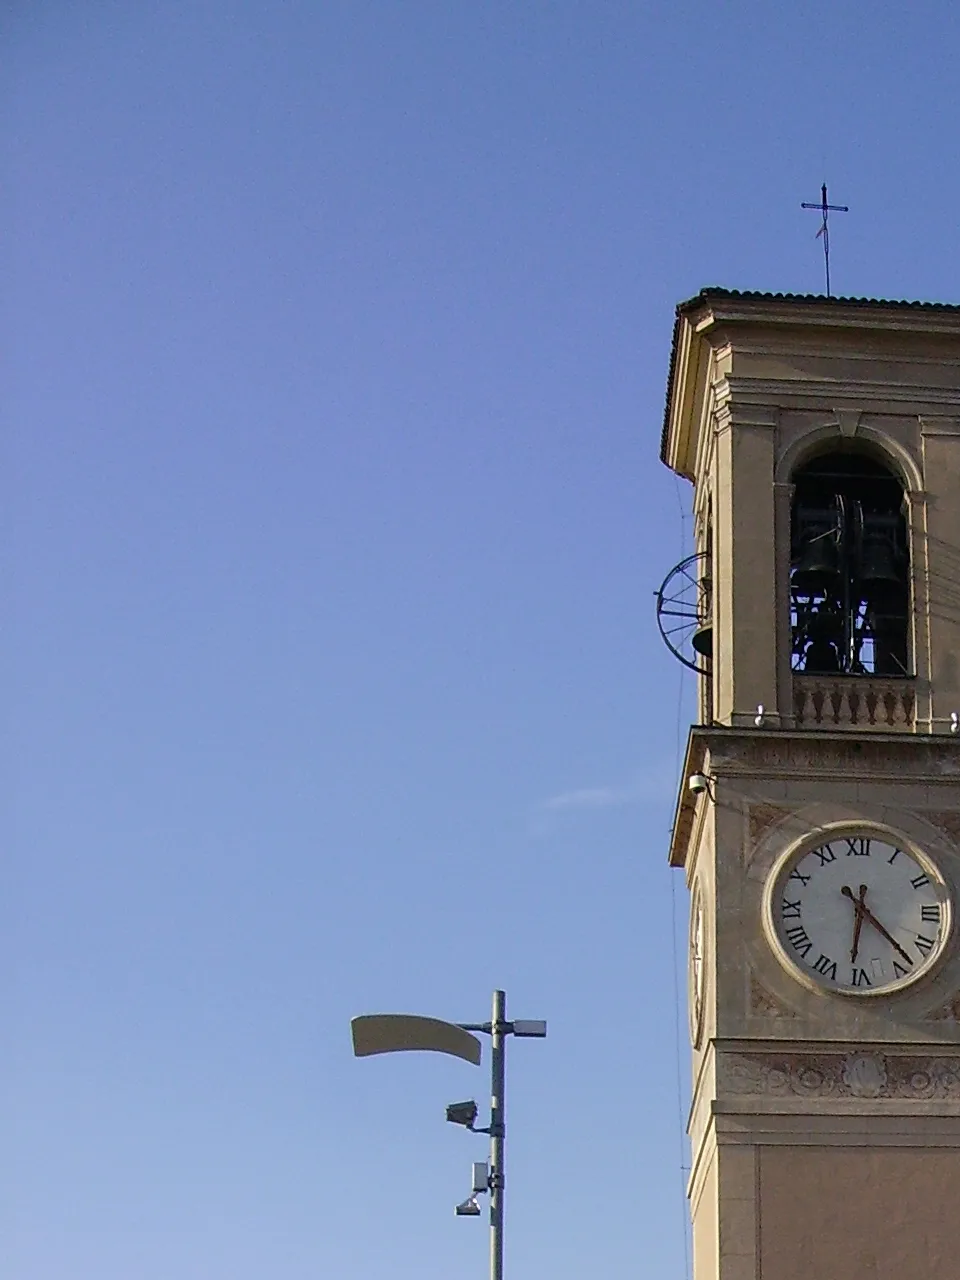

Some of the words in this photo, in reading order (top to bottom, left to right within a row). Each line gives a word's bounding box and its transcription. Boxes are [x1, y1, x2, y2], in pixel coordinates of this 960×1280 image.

[813, 844, 837, 866] XI
[846, 838, 870, 856] XII
[888, 849, 901, 864] I
[791, 869, 811, 886] X
[911, 874, 929, 889] II
[782, 899, 801, 919] IX
[922, 905, 940, 922] III
[787, 926, 812, 957] VIII
[915, 934, 934, 957] IV
[813, 955, 837, 980] VII
[851, 968, 871, 985] VI
[893, 961, 908, 979] V
